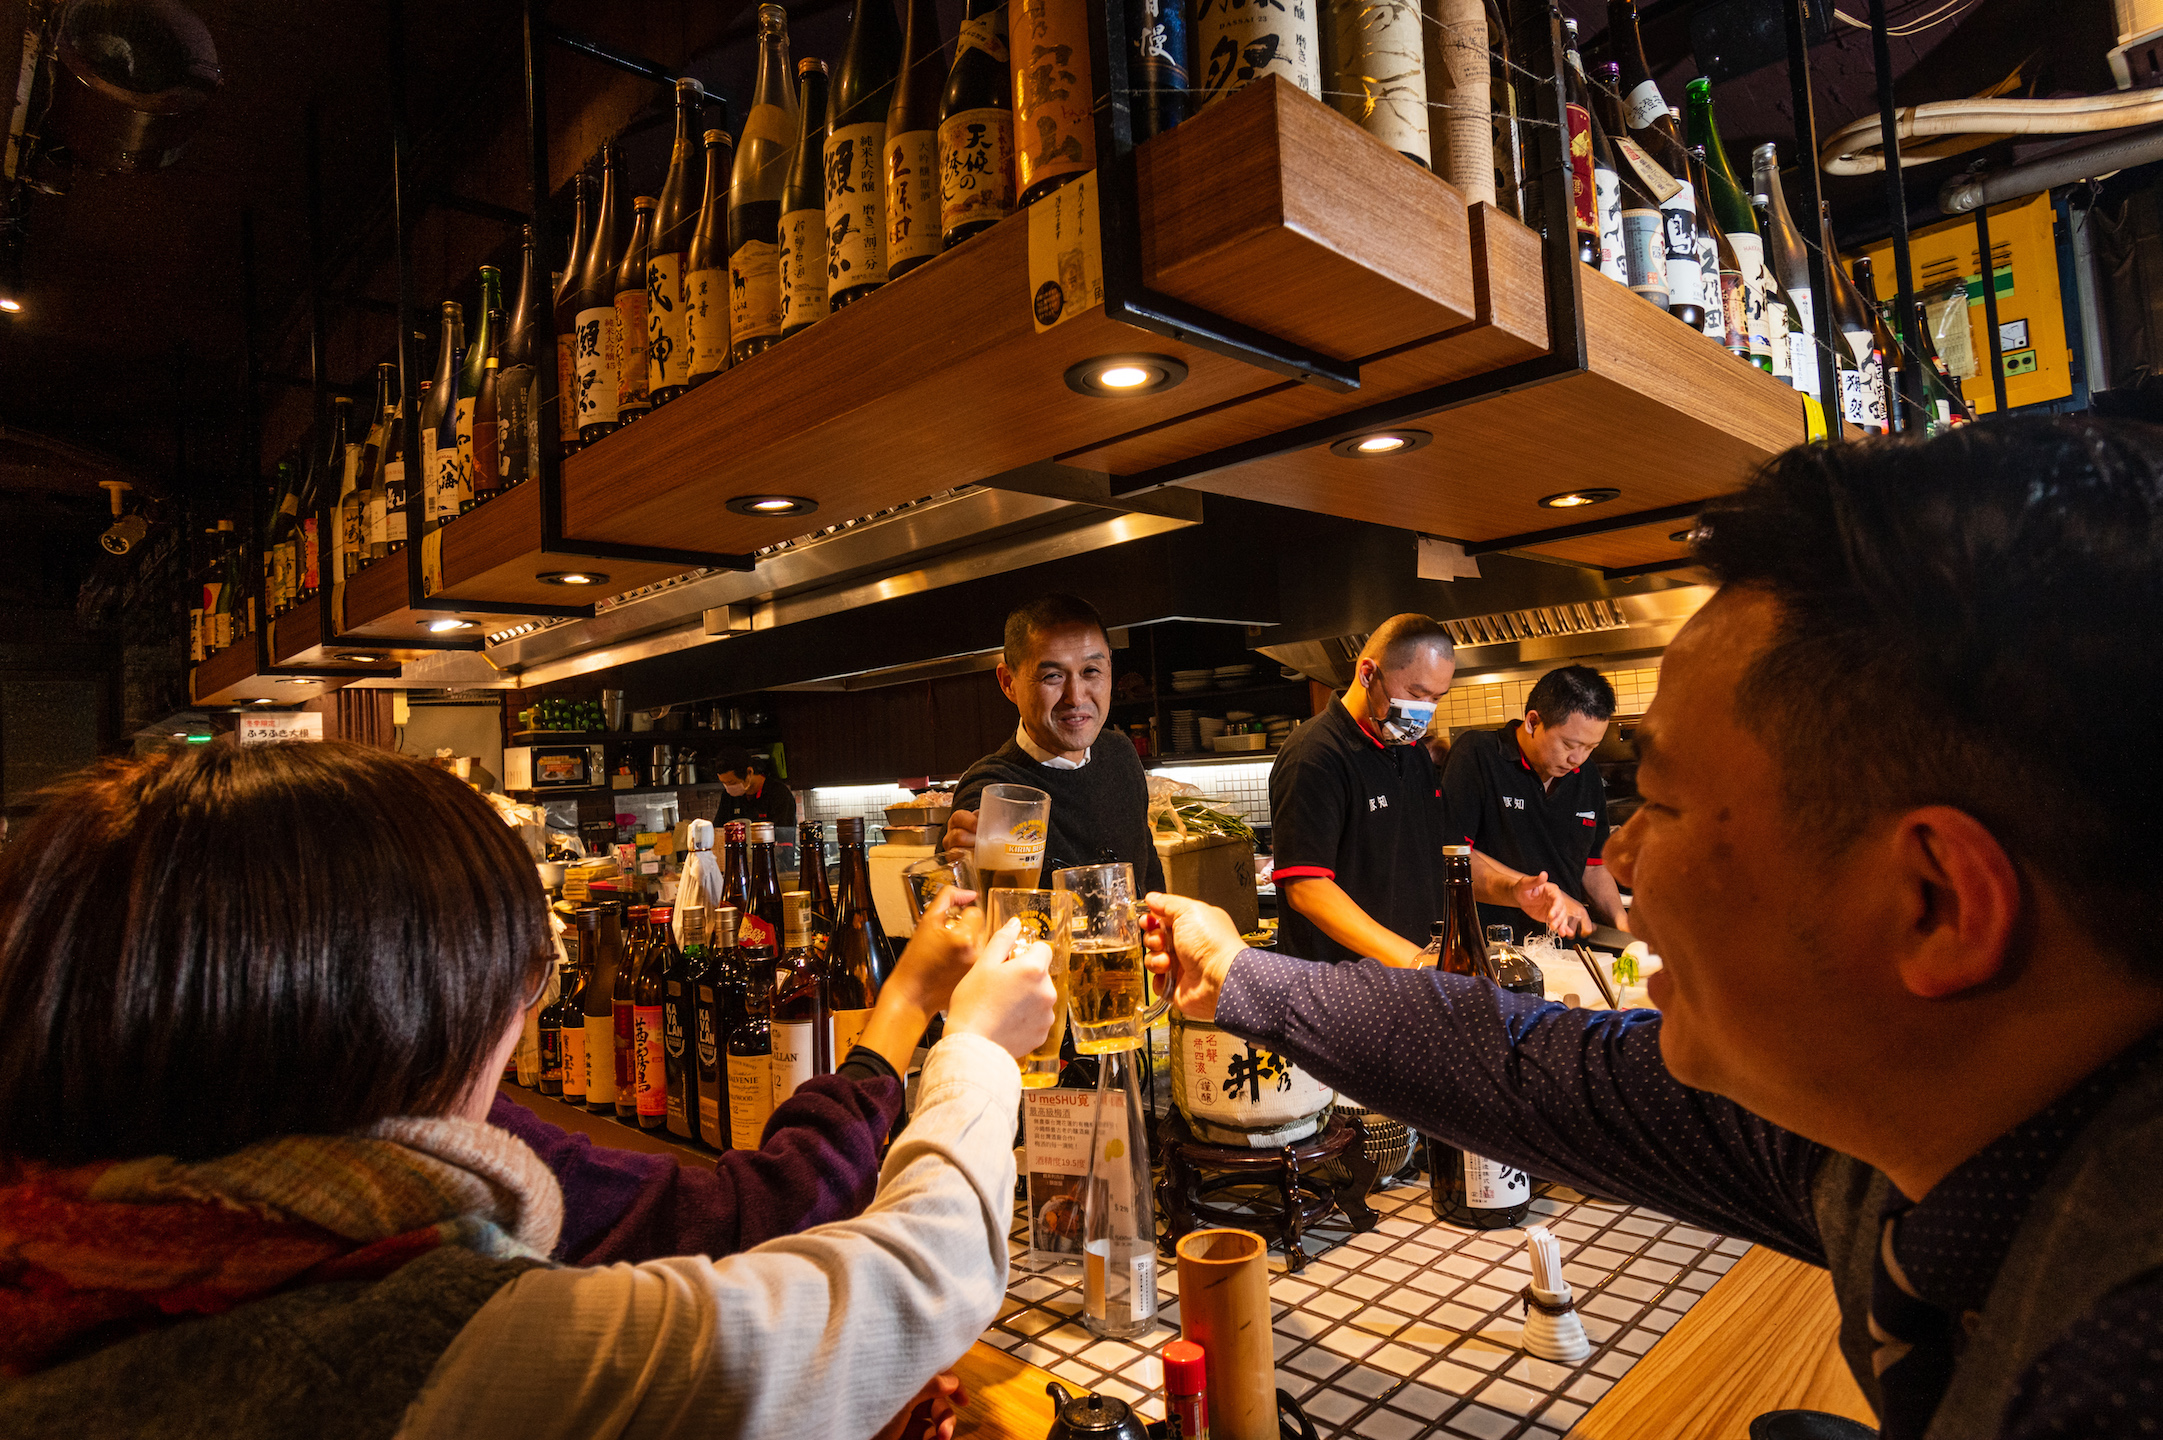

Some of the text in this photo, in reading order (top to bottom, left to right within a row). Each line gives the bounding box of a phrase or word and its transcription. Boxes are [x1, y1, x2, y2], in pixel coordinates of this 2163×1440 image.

[1219, 15, 1268, 30] DASSAI 23
[963, 123, 993, 191] 天使の
[859, 135, 878, 271] 純米大吟醸 磨き二割三分
[247, 729, 309, 738] ふろふき大根
[772, 1052, 798, 1062] ALLAN
[1028, 1093, 1036, 1103] U
[1029, 1107, 1071, 1118] 最高級梅酒
